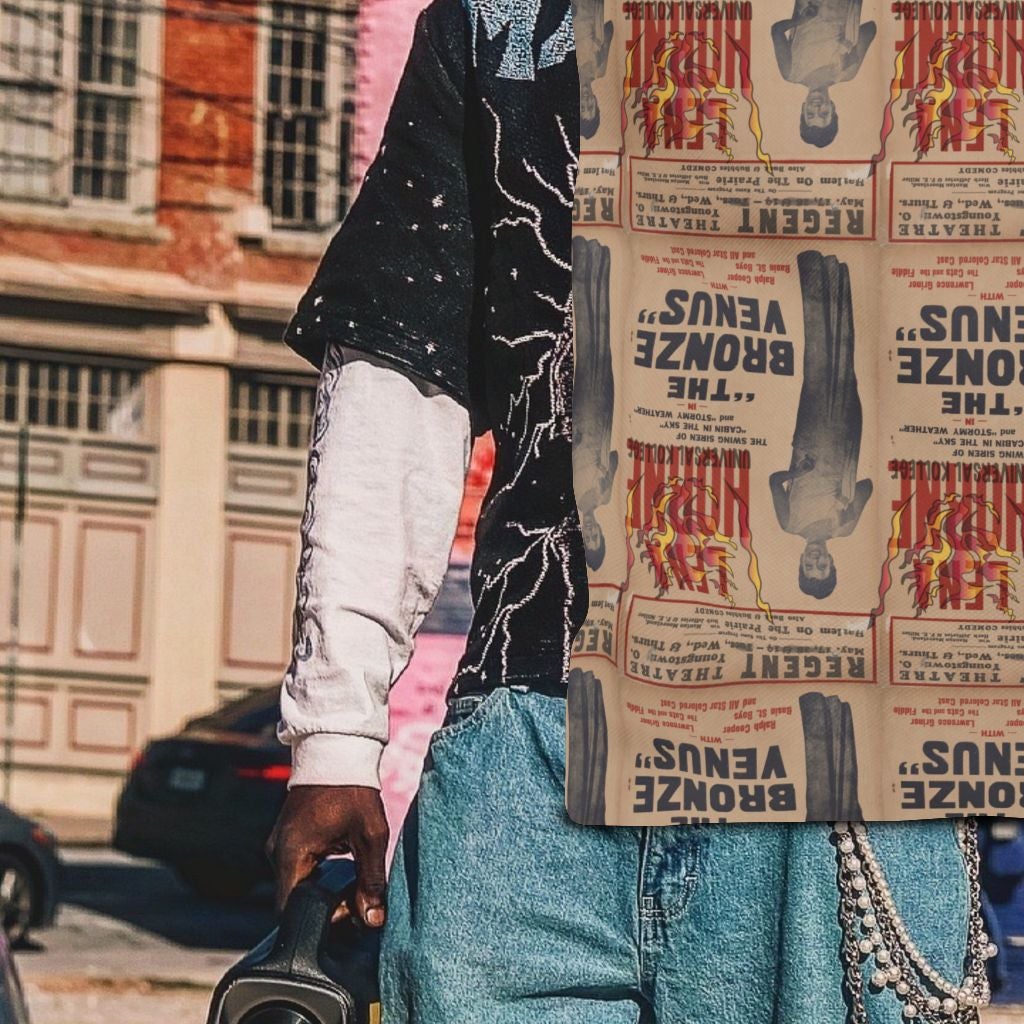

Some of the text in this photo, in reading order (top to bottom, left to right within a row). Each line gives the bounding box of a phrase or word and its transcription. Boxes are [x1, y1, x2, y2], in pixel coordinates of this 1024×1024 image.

[623, 0, 752, 20] UNIVERSAL KOLLEGE
[892, 0, 952, 20] KOLLEGE
[898, 199, 939, 208] Thurs.
[944, 200, 953, 208] &
[572, 198, 614, 222] REG
[636, 208, 864, 235] REGENT THEATRE
[898, 224, 1000, 236] THEATRE
[937, 256, 955, 265] Cast
[959, 256, 989, 265] Colored
[991, 256, 1008, 265] Star
[1011, 256, 1021, 265] All
[891, 268, 915, 277] Fiddle
[946, 268, 964, 277] Cats
[710, 281, 728, 290] WITH
[908, 281, 974, 290] Lawrence Griner
[638, 289, 786, 335] VENUS”
[634, 330, 794, 376] BRONZE
[668, 377, 755, 402] “THE
[954, 428, 997, 436] “STORMY
[960, 438, 978, 446] THE
[982, 439, 992, 447] IN
[952, 449, 964, 457] OF
[967, 449, 995, 458] SIREN
[890, 458, 949, 482] KOLLEGE
[630, 654, 865, 682] REGENT THEATRE
[899, 670, 1001, 683] THEATRE
[700, 736, 722, 744] WITH
[635, 738, 787, 779] VENUS”
[633, 776, 797, 813] BRONZE
